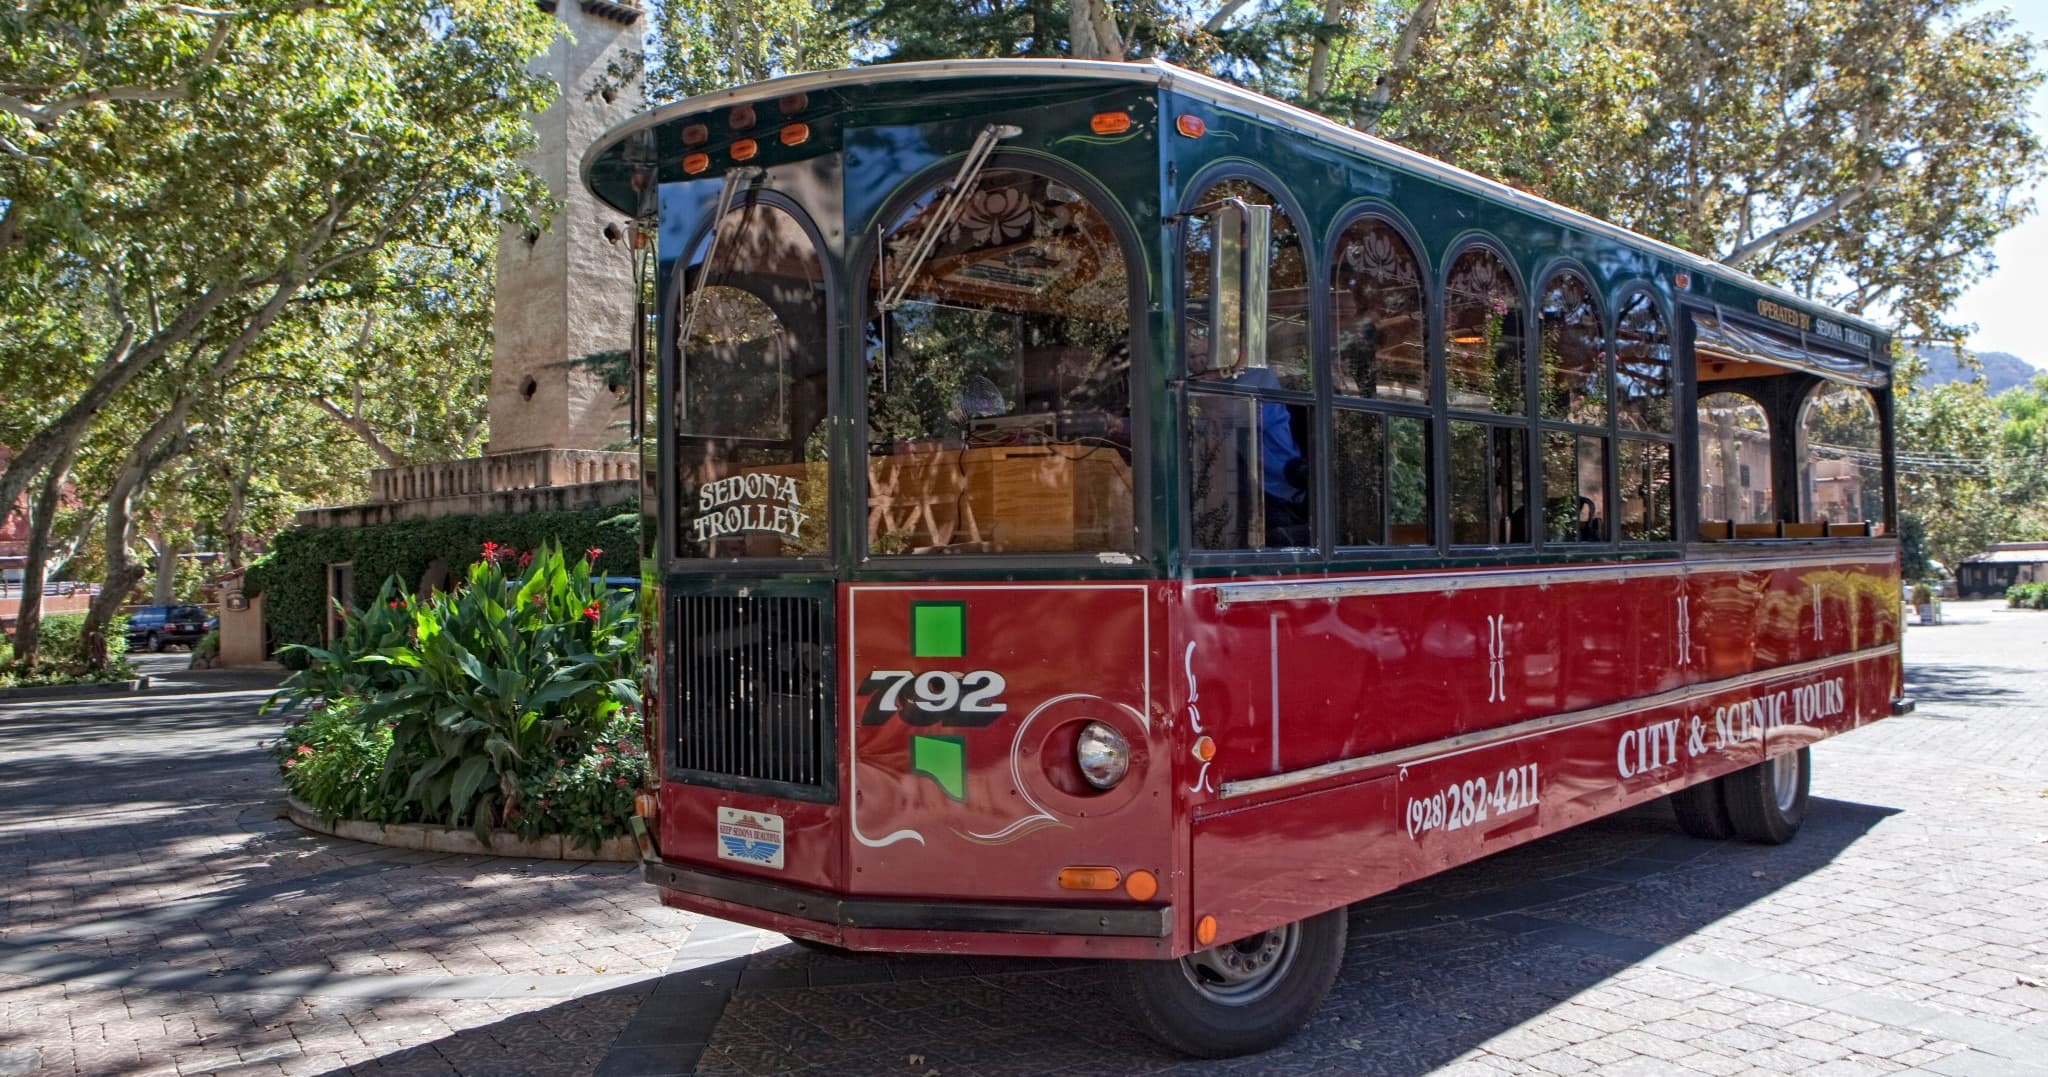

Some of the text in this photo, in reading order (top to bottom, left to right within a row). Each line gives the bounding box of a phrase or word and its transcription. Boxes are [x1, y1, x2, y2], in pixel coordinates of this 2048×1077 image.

[1757, 299, 1872, 350] OPERATED BY SEDONA TROLLEY
[699, 473, 801, 511] SEDONA
[694, 504, 810, 541] TROLLEY
[868, 670, 1008, 713] 792
[1617, 677, 1844, 778] CITY & SCENIC TOURS
